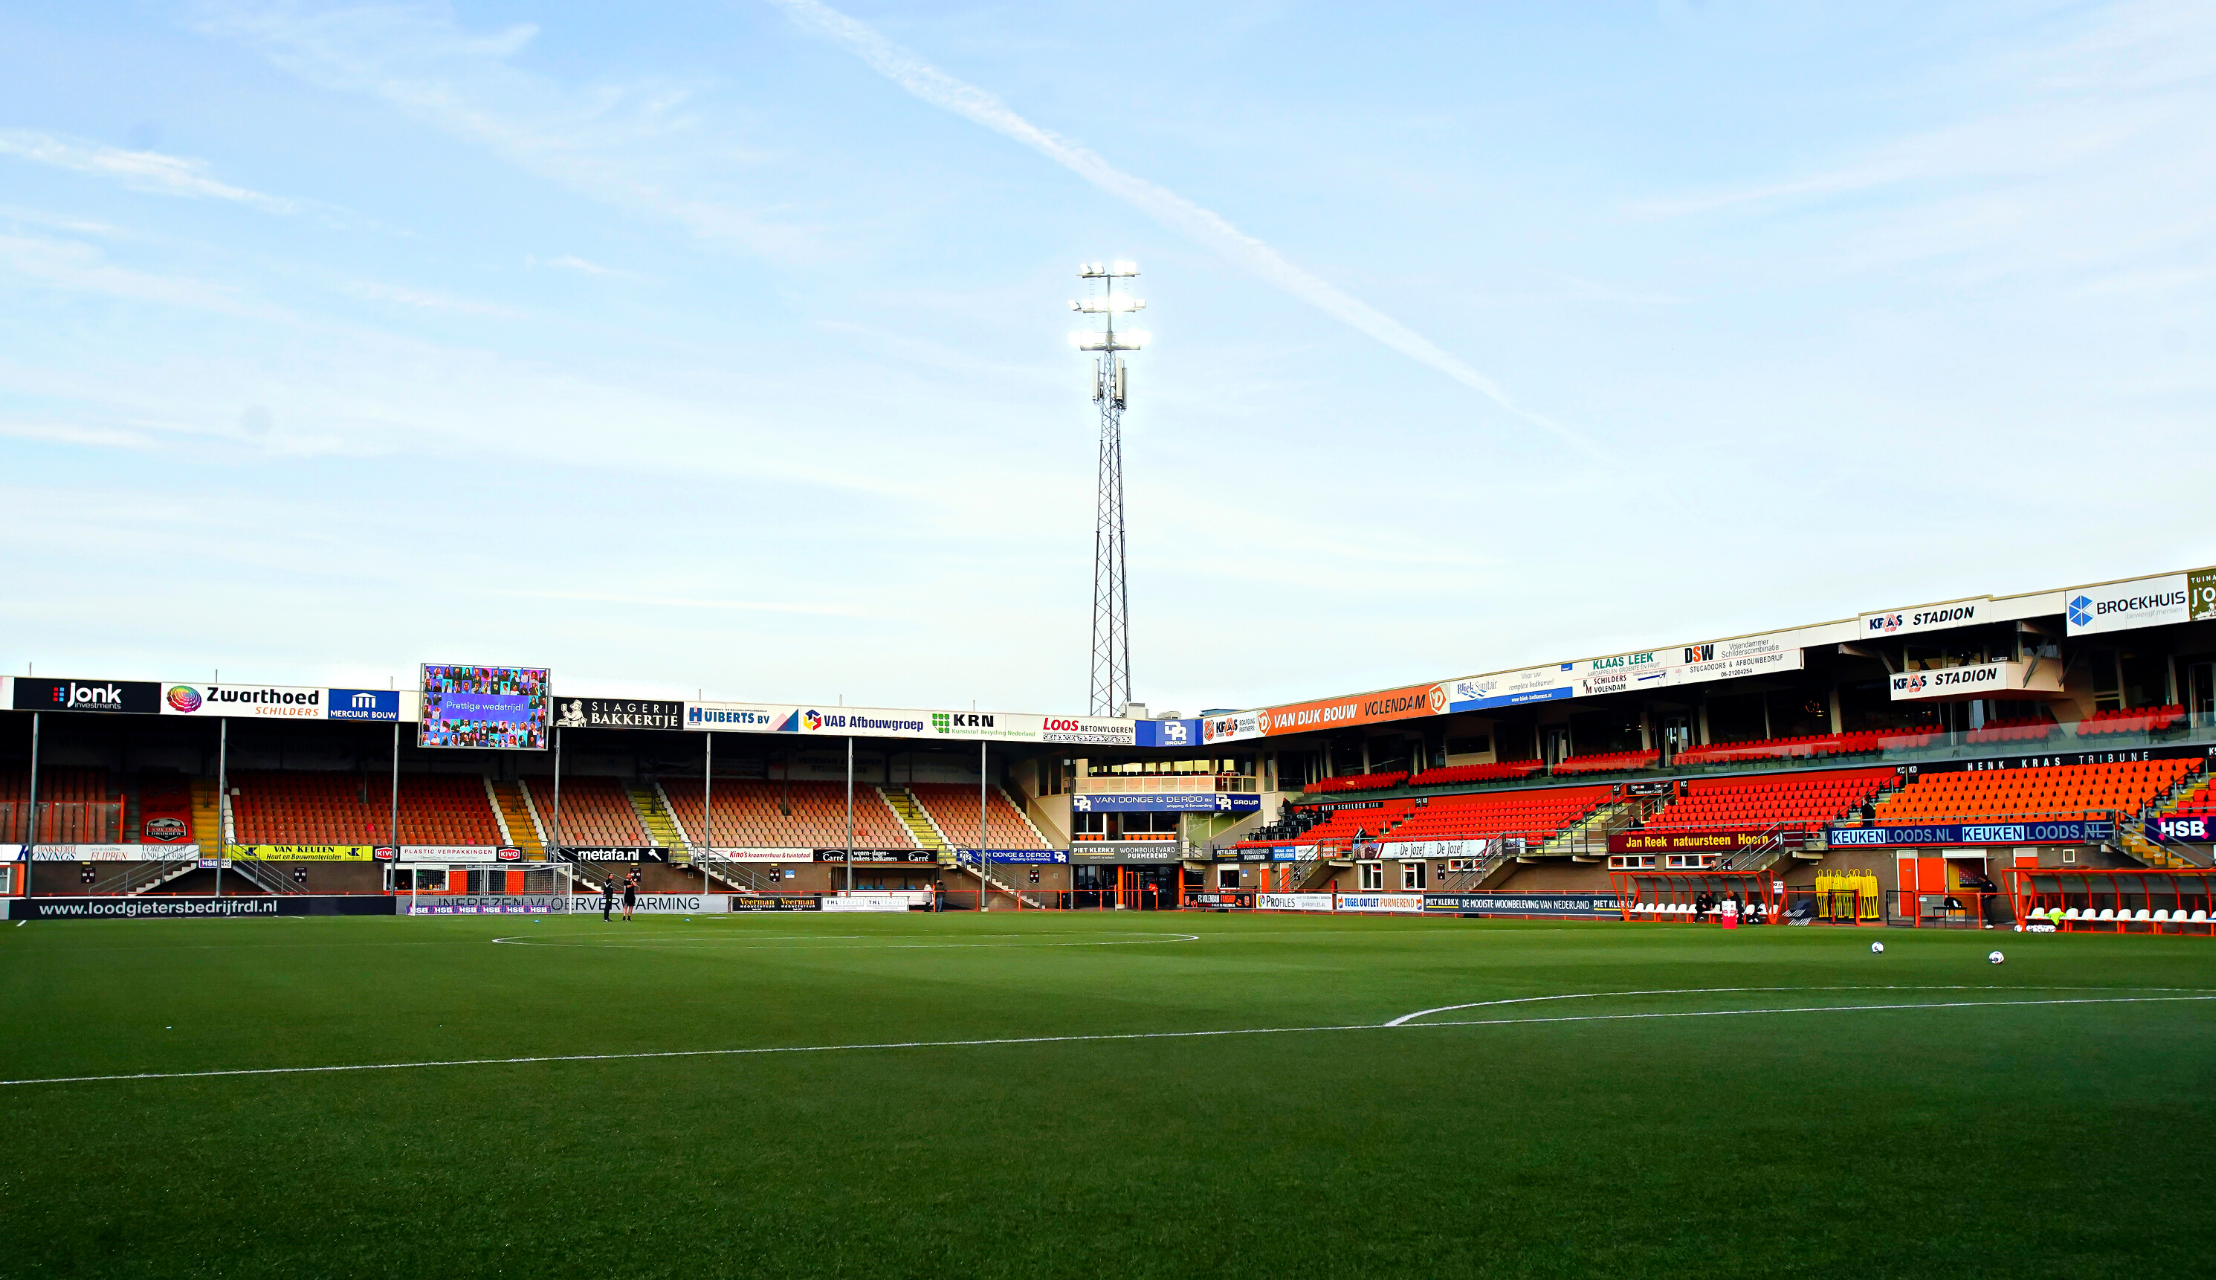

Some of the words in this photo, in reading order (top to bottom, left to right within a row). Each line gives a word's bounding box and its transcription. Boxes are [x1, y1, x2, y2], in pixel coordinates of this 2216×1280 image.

[2096, 591, 2186, 615] BROEKHUIS
[1869, 613, 1903, 631] KRAS
[1913, 606, 1975, 626] STADION
[1684, 643, 1715, 664] DSW
[1593, 656, 1625, 670] KLAAS
[1628, 652, 1654, 665] LEEK
[1728, 660, 1733, 668] &
[1593, 675, 1627, 685] SCHILDERS
[1893, 675, 1927, 691] KRAS
[1935, 667, 1997, 686] STADION
[1594, 683, 1627, 694] VOLENDAM
[206, 686, 319, 706] Zwarthoed
[74, 702, 122, 710] investments
[255, 706, 320, 717] SCHILDERS
[446, 701, 481, 712] Prettige
[482, 702, 525, 712] wedstrijd!
[591, 701, 679, 714] SLAGERIJ
[1274, 712, 1296, 729] VAN
[1297, 708, 1322, 726] DIJK
[1323, 704, 1358, 722] BOUW
[1364, 694, 1426, 717] VOLENDAM
[330, 709, 369, 719] MERCUUR
[371, 711, 397, 719] BOUW
[591, 713, 679, 727] BAKKERTJE
[689, 707, 755, 724] HUIBERTS
[757, 715, 770, 724] BV
[953, 714, 994, 728] KRN
[824, 715, 847, 728] VAB
[849, 716, 924, 733] Afbouwgroep
[1043, 717, 1079, 732] LOOS
[1080, 725, 1134, 734] BETONVLOEREN
[980, 729, 1007, 737] Recycling
[1967, 761, 2005, 772] HENK
[2021, 757, 2061, 769] KRAS
[2078, 751, 2150, 764] TRIBUNE
[2160, 820, 2206, 837] HSB
[1626, 836, 1643, 848] Jan
[1644, 836, 1667, 847] Reek
[1673, 834, 1731, 846] natuursteen
[1737, 833, 1769, 845] Hoorn
[577, 848, 640, 861] metafa.nl
[729, 850, 748, 859] Kino's
[1400, 844, 1409, 855] De
[1410, 843, 1426, 858] Jozef
[1436, 842, 1445, 855] De
[1447, 842, 1464, 857] Jozef
[266, 853, 282, 861] Hout
[822, 852, 844, 862] Carré
[908, 852, 930, 862] Carré
[530, 897, 700, 911] VLOERVERARMING
[739, 897, 775, 905] Veerman
[780, 897, 815, 905] Veerman
[1380, 898, 1415, 908] PURMEREND
[1425, 898, 1437, 906] PIET
[1437, 898, 1459, 906] KLERKX
[1462, 899, 1470, 908] DE
[1470, 899, 1494, 908] MOOISTE
[1494, 899, 1540, 909] WOONBELEVING
[1539, 899, 1553, 909] VAN
[1553, 900, 1590, 910] NEDERLAND
[1593, 899, 1608, 908] PIET
[39, 900, 278, 917] www.loodgietersbedrijfrdl.nl
[459, 906, 478, 914] HSB
